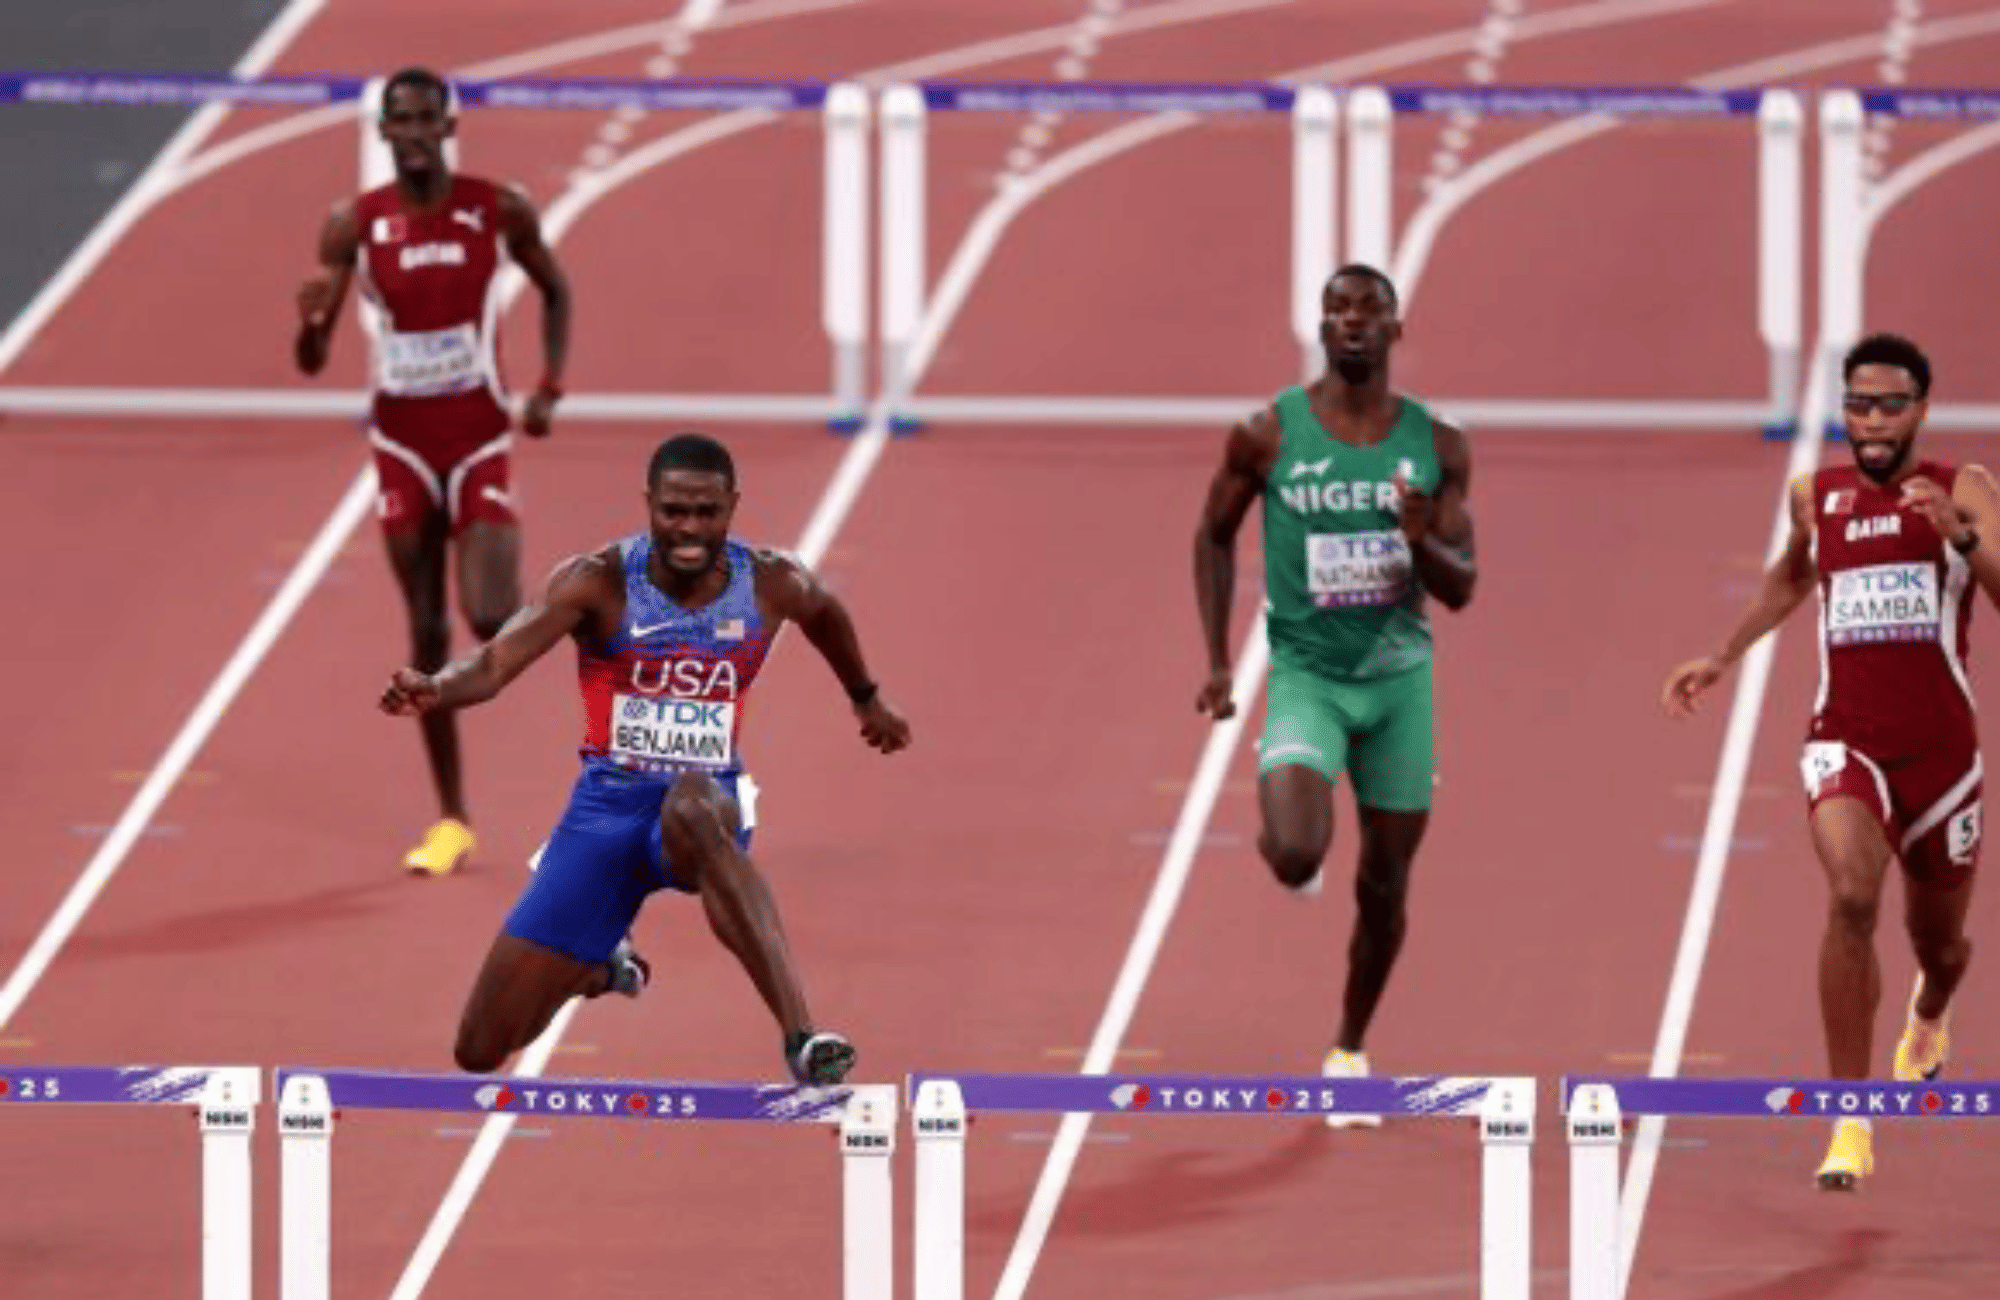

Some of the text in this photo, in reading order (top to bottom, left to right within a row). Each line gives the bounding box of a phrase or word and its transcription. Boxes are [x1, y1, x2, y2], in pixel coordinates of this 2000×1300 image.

[1278, 480, 1402, 515] NIGER
[1859, 567, 1927, 593] TDK
[1834, 595, 1930, 623] SAMBA
[631, 659, 737, 699] USA
[654, 700, 727, 728] TDK
[616, 725, 724, 758] BENJAMIN
